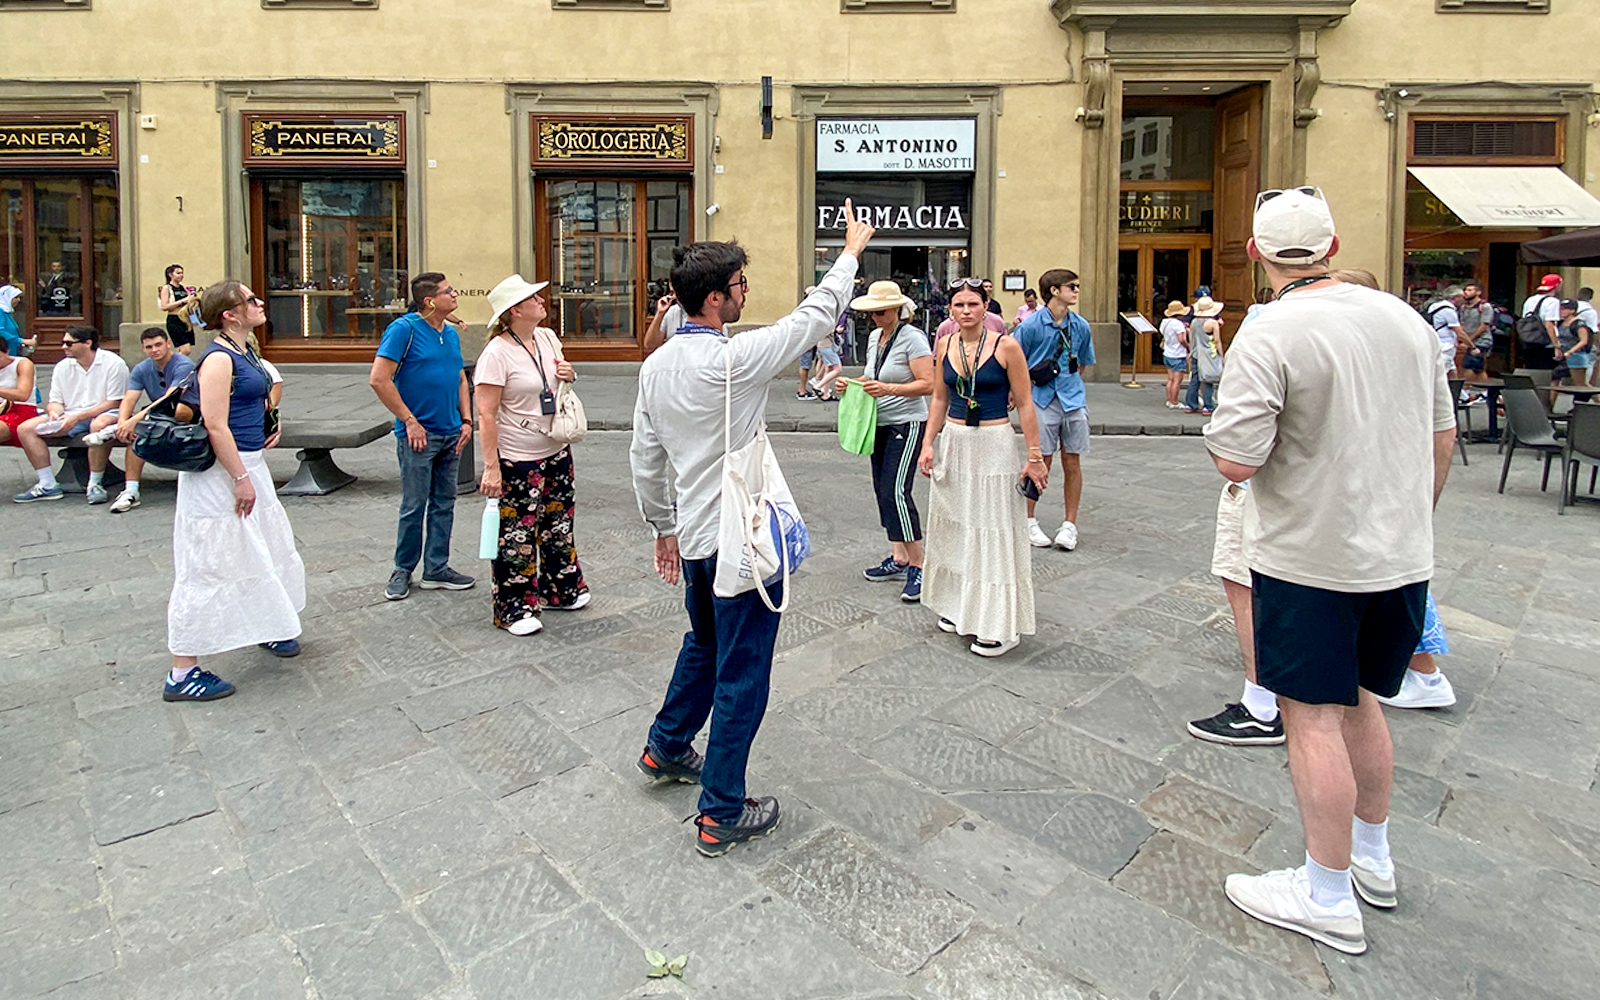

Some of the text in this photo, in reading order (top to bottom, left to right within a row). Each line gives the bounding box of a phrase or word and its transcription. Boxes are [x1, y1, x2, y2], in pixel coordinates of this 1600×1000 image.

[819, 123, 880, 135] FARMACIA
[0, 132, 86, 146] PANERAI
[277, 132, 372, 145] PANERAI
[554, 131, 671, 150] OROLOGERIA
[834, 139, 958, 153] S. ANTONINO
[904, 157, 915, 169] D.
[918, 157, 972, 169] MASOTTI
[817, 205, 966, 229] FARMACIA
[1118, 204, 1190, 220] CUDIERI
